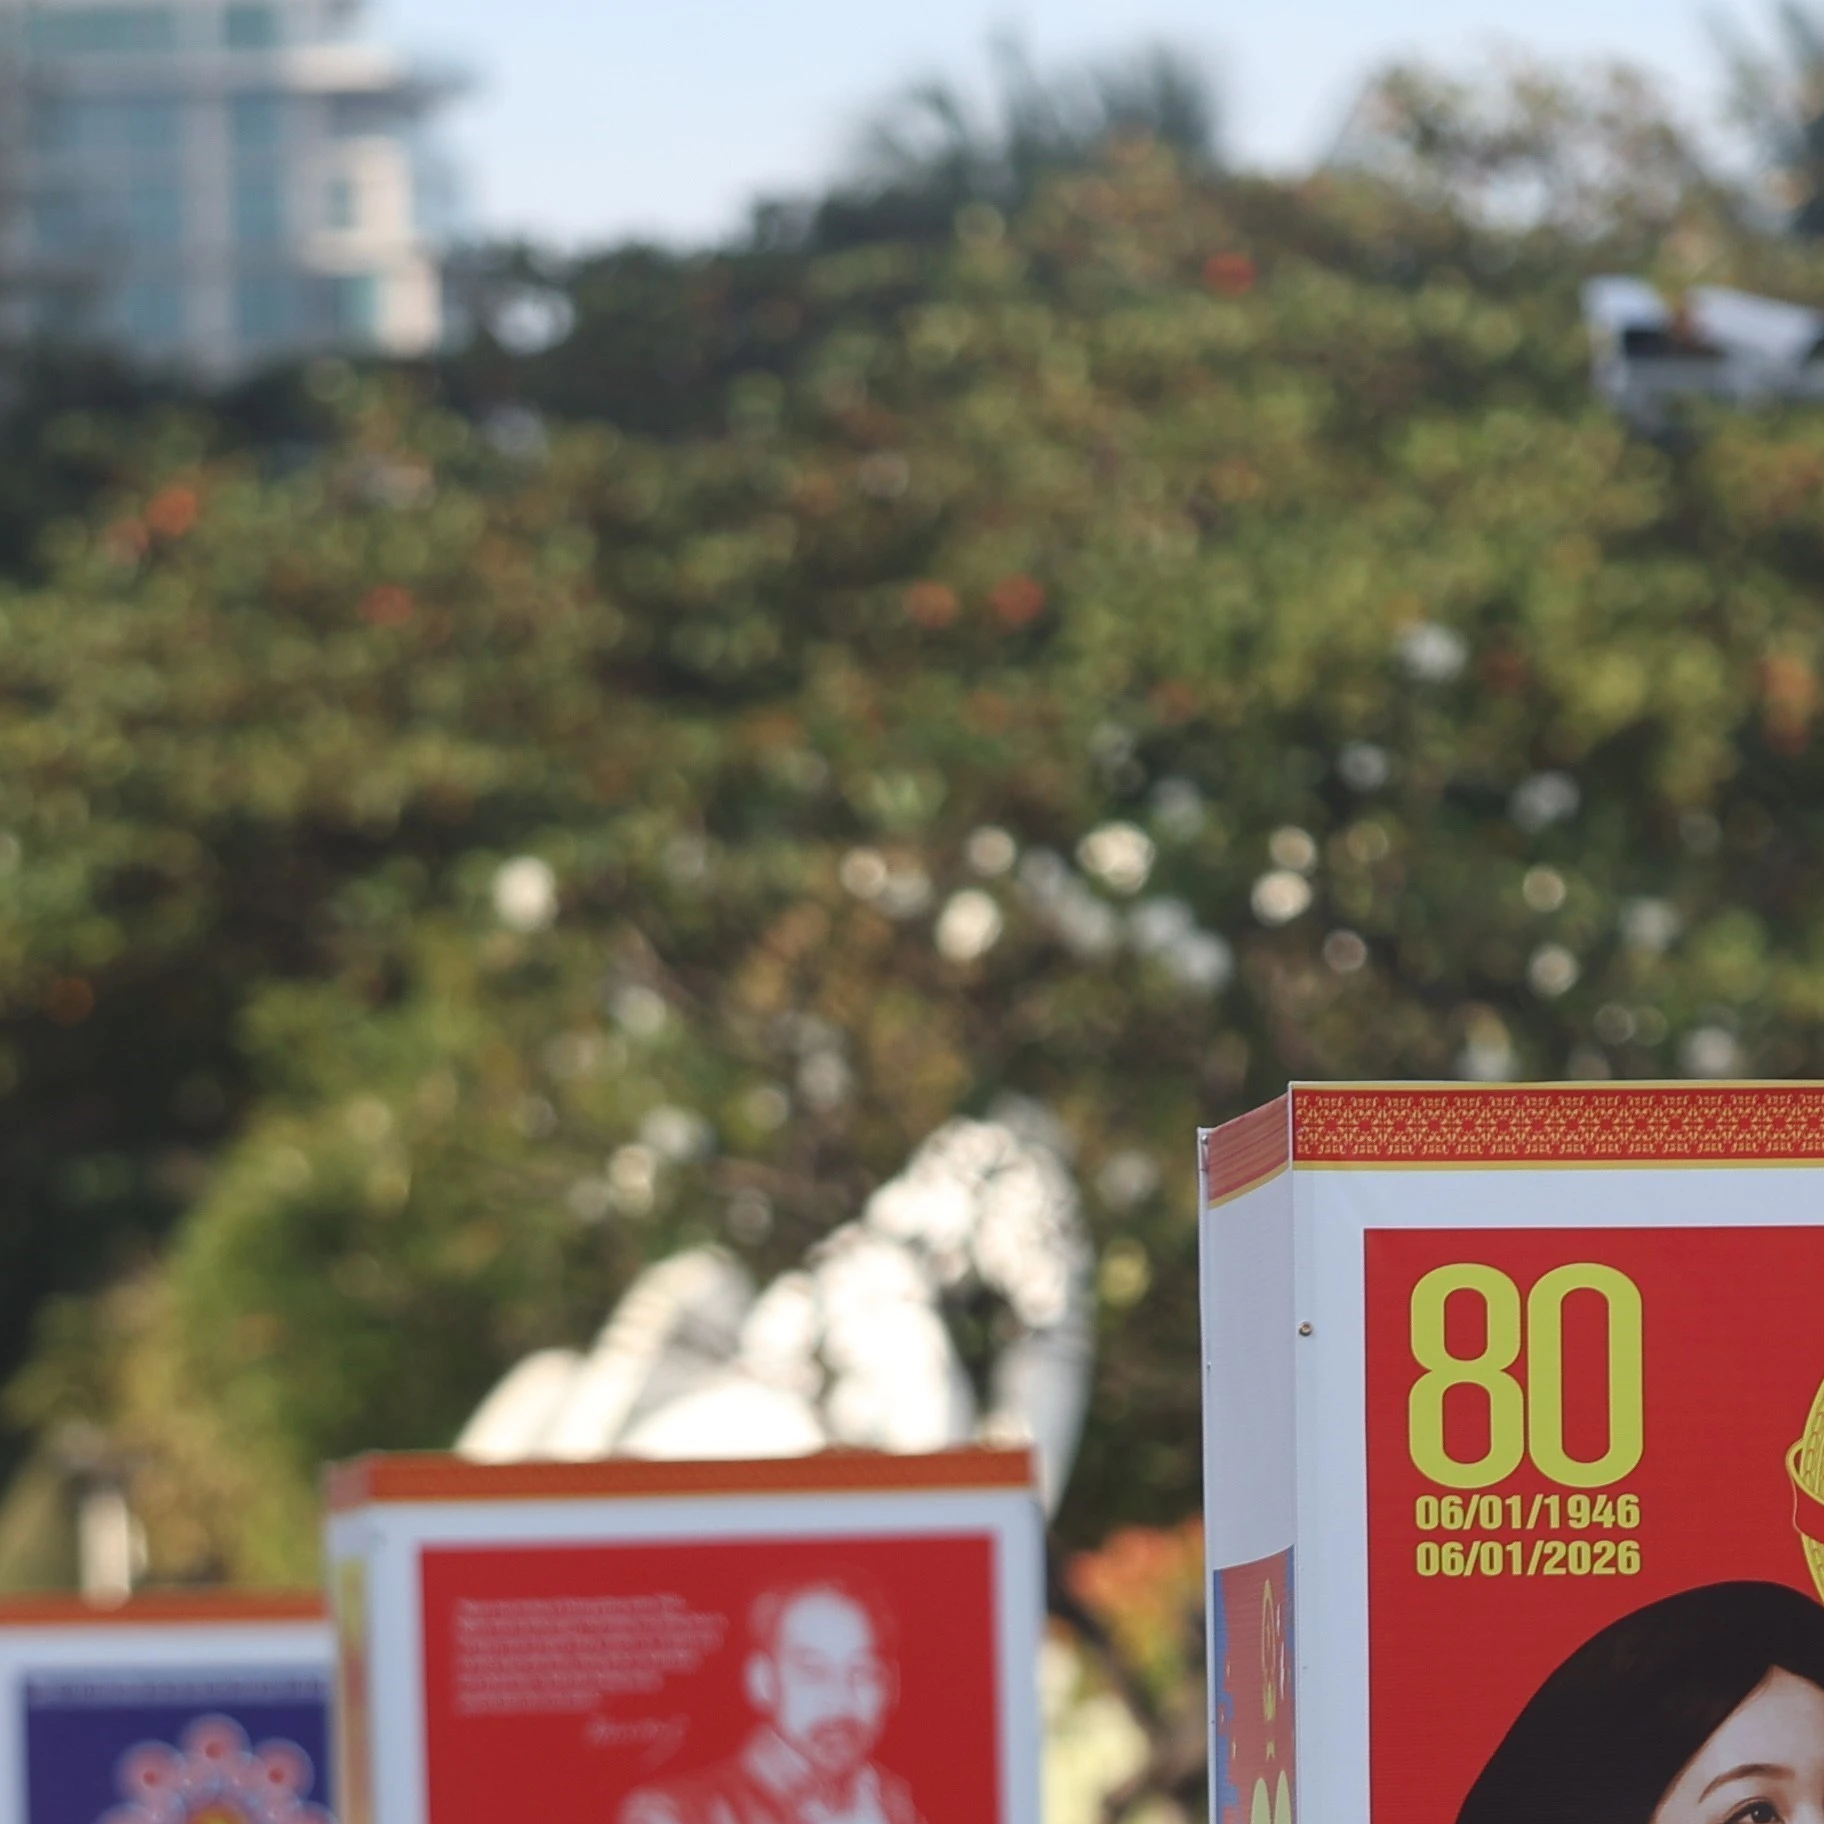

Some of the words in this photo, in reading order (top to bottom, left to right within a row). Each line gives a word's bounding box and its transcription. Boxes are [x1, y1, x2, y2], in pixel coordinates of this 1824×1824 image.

[1409, 1263, 1643, 1489] 80
[1416, 1493, 1640, 1530] 06/01/1946
[1416, 1539, 1641, 1577] 06/01/2026
